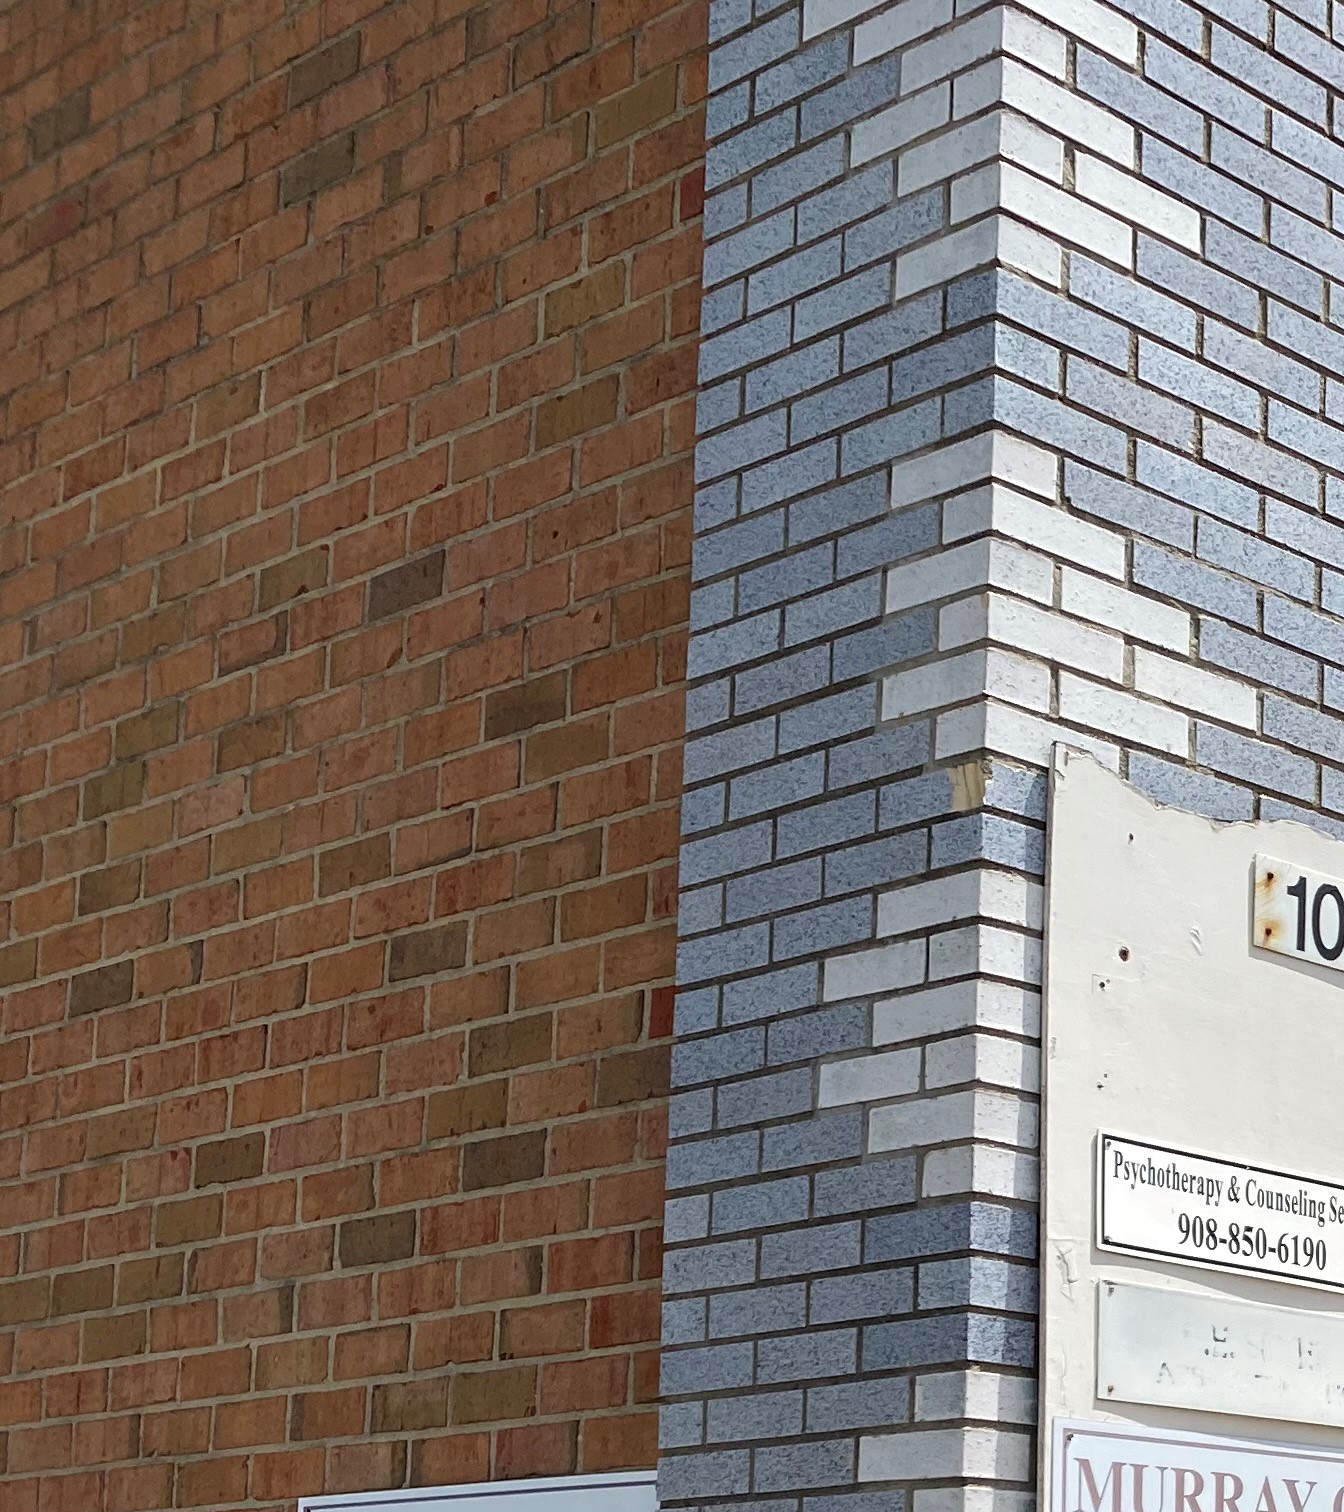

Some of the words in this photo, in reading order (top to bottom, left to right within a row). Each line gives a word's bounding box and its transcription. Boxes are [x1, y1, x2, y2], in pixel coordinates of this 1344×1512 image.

[1112, 1150, 1224, 1206] Psychotherapy
[1227, 1176, 1240, 1202] &
[1245, 1179, 1325, 1227] Counseling
[1178, 1213, 1326, 1270] 908-850-6190
